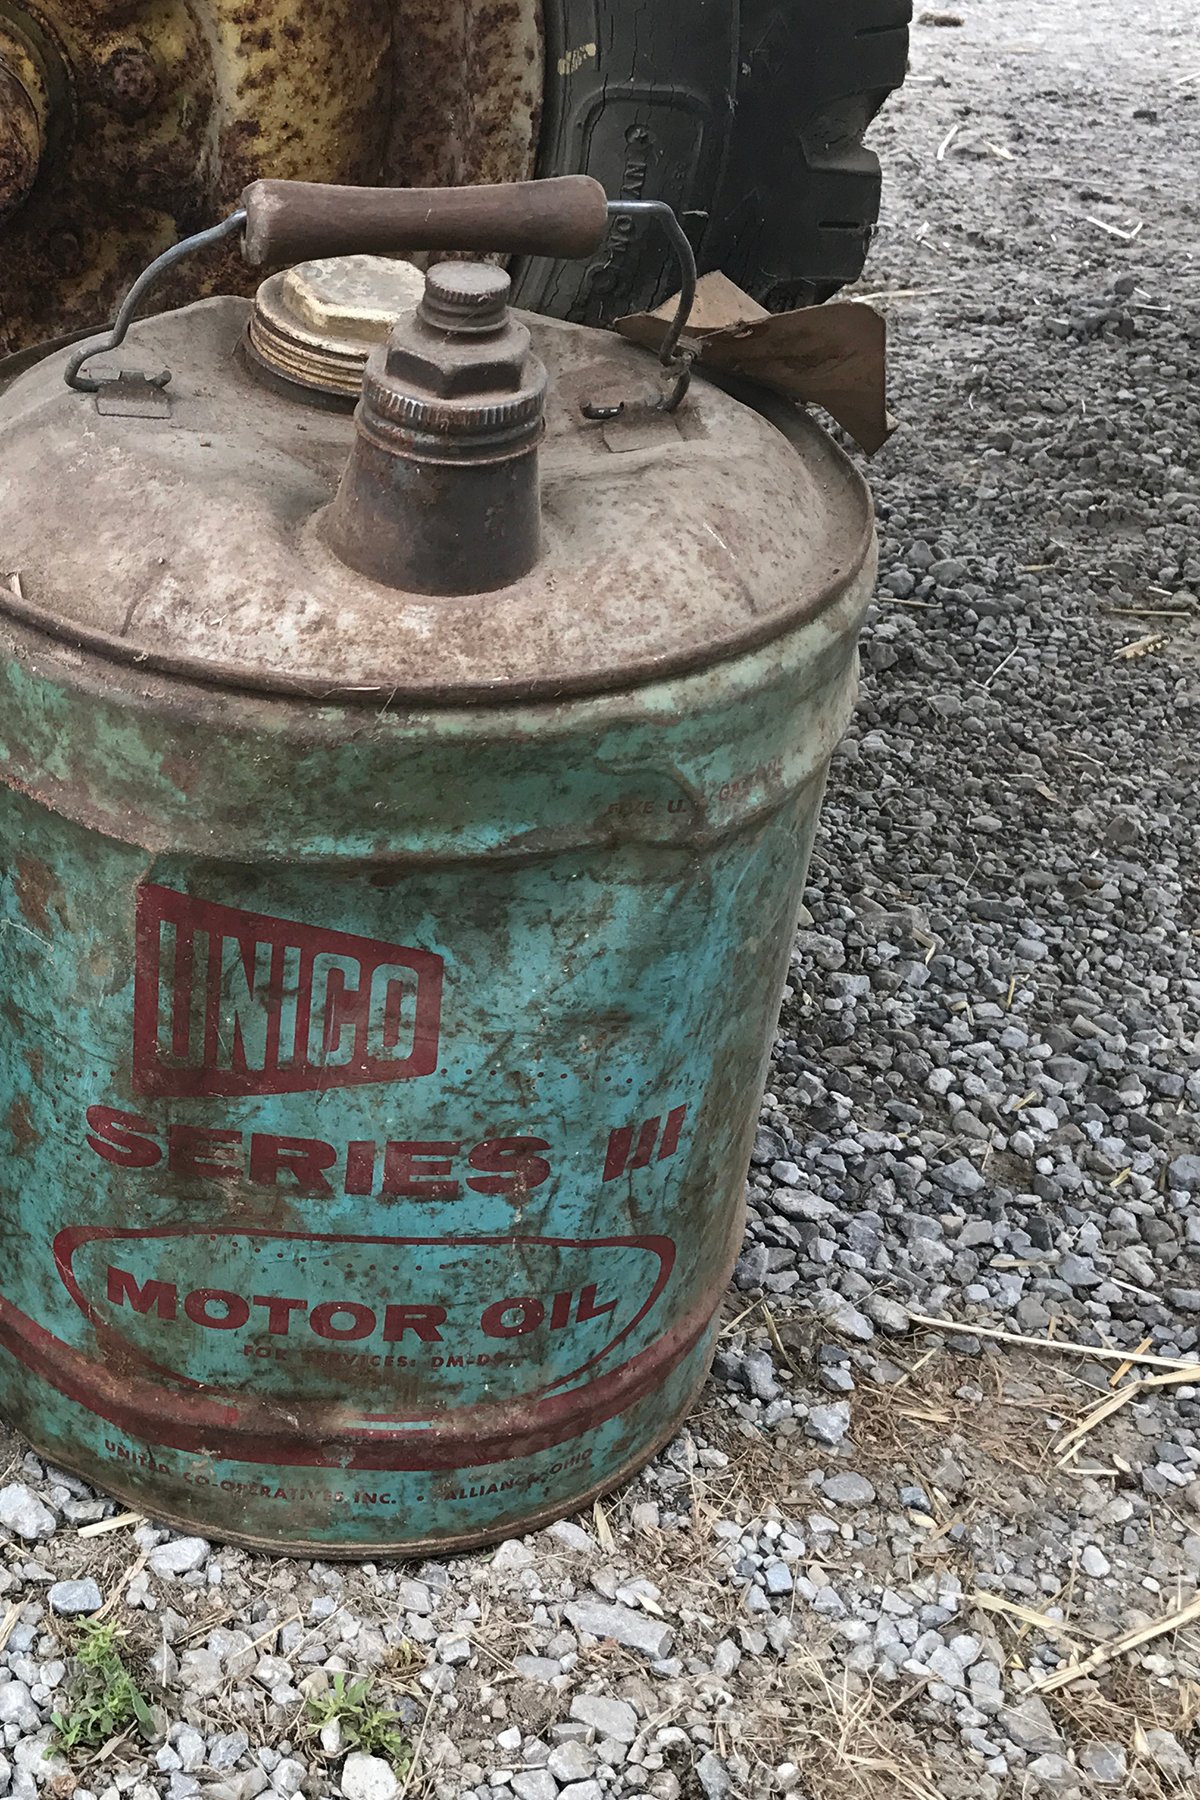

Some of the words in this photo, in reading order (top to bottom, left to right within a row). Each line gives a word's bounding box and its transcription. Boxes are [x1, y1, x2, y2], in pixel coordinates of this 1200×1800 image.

[606, 162, 648, 252] NYON
[155, 918, 420, 1072] UNICO
[85, 1104, 551, 1201] SERIES
[602, 1103, 688, 1183] III
[106, 1264, 445, 1343] MOTOR
[480, 1283, 621, 1339] OIL
[302, 1350, 417, 1368] VICES:
[353, 1491, 397, 1505] INC.
[550, 1447, 593, 1475] OHIO
